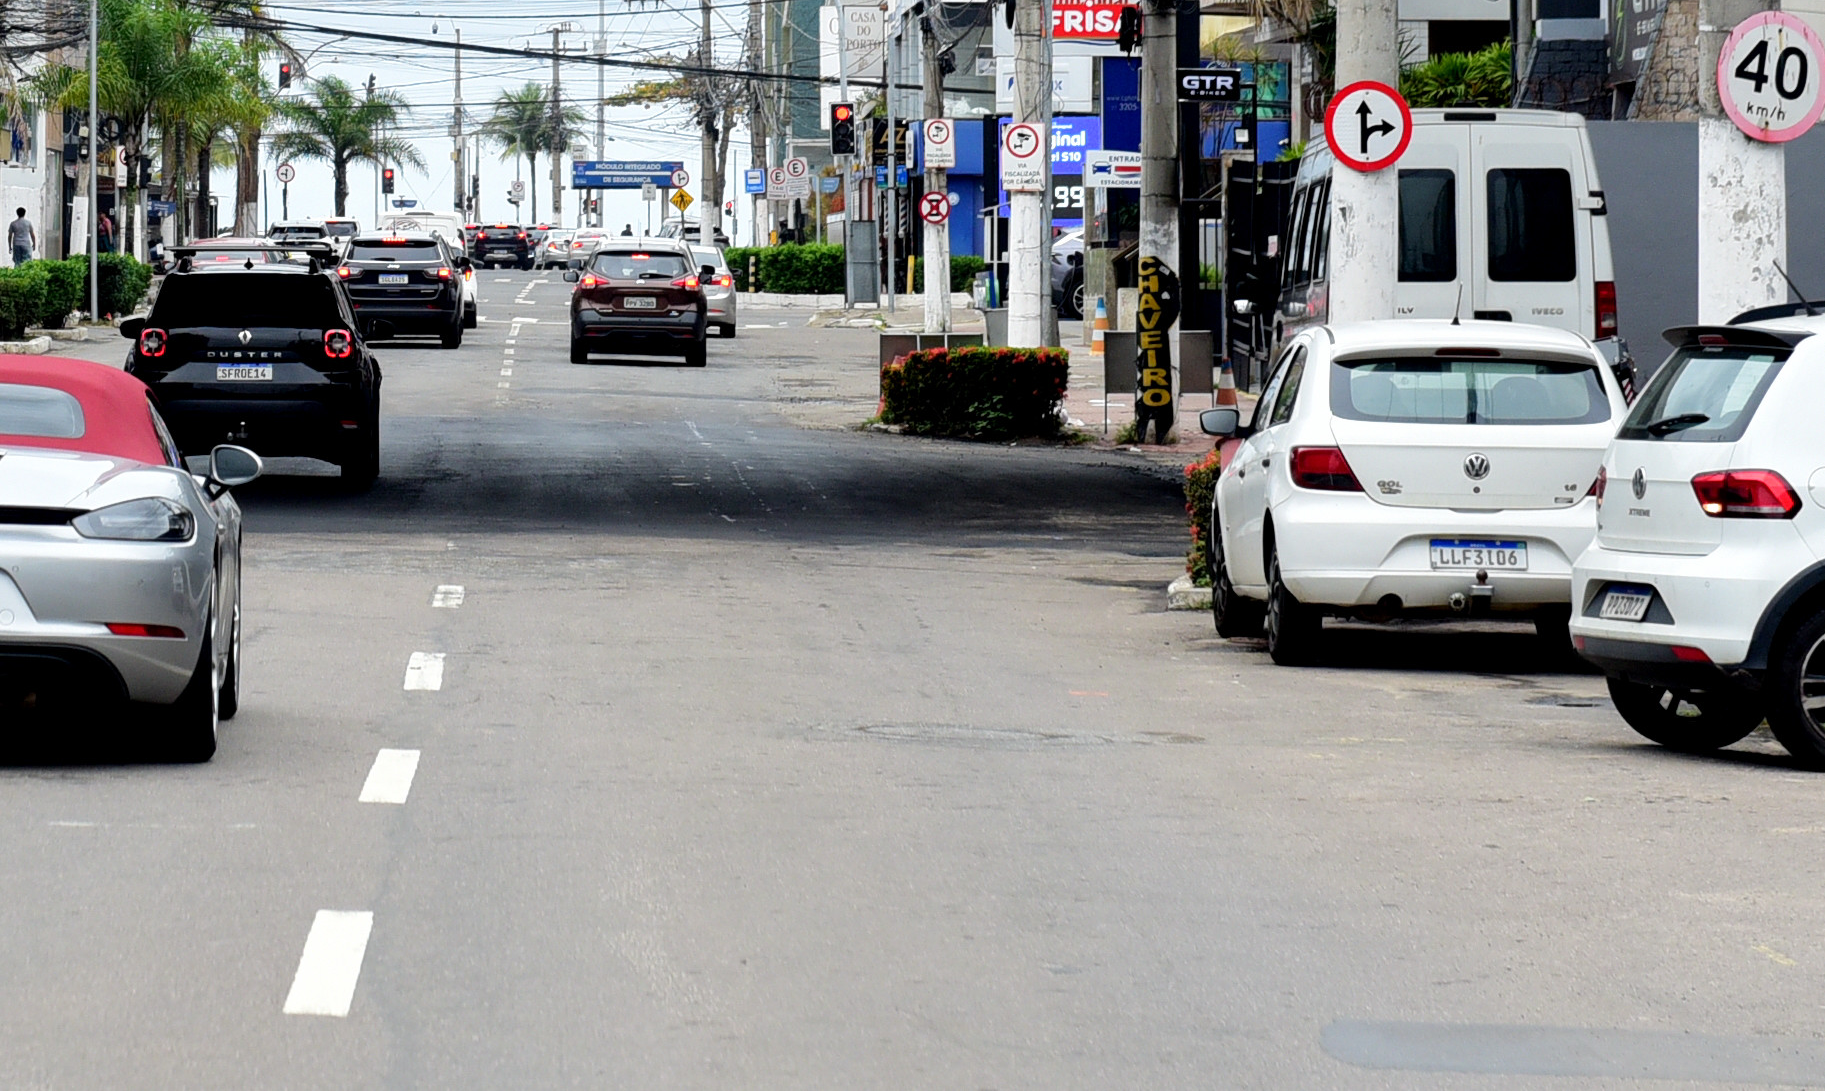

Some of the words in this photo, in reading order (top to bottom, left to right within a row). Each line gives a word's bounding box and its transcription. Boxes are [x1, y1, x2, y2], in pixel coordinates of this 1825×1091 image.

[850, 11, 877, 23] CASA
[1051, 9, 1122, 33] FRIS
[856, 25, 872, 36] DO
[846, 39, 880, 51] PORTO
[1734, 39, 1809, 100] 40
[1182, 75, 1234, 90] GTR
[1746, 101, 1786, 122] km/h
[1051, 130, 1086, 150] ginal
[1062, 152, 1082, 162] S10
[1108, 155, 1141, 163] ENTRAD
[792, 163, 800, 174] E
[775, 171, 782, 181] E
[1050, 186, 1085, 211] ,99
[1138, 256, 1171, 407] CHAVEIRO
[207, 351, 283, 359] DUSTER
[1377, 480, 1403, 488] GOL
[1629, 508, 1651, 517] XTREME
